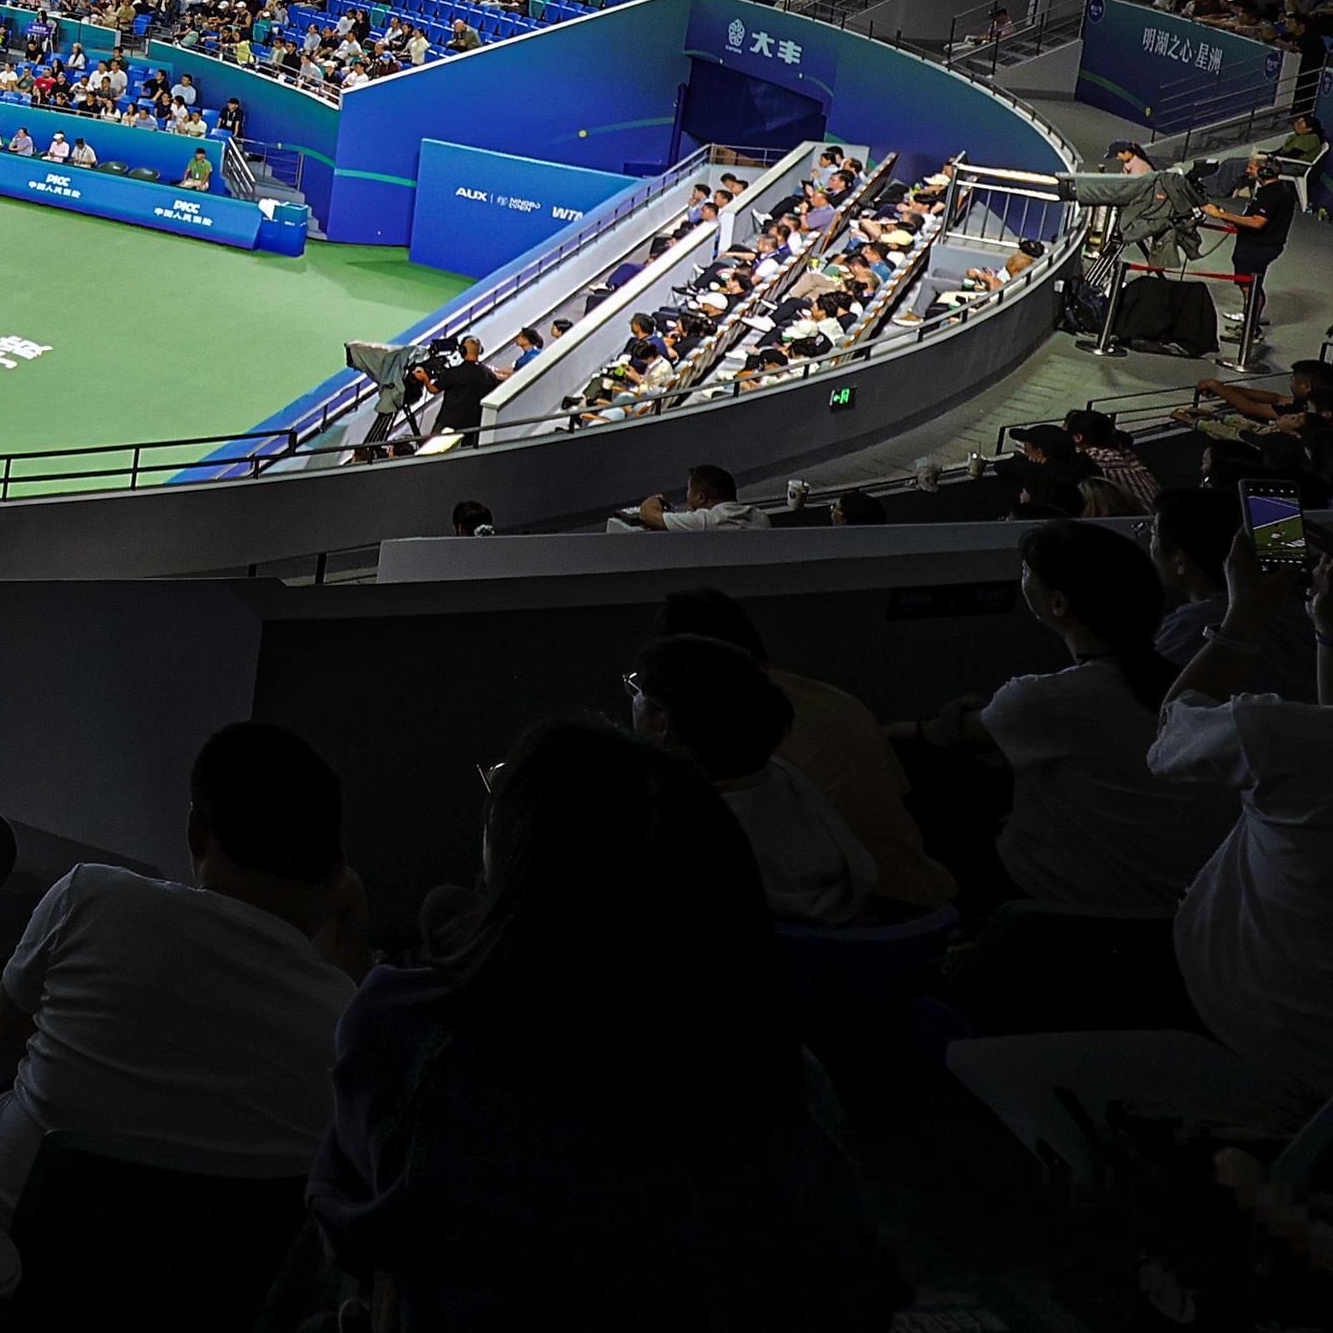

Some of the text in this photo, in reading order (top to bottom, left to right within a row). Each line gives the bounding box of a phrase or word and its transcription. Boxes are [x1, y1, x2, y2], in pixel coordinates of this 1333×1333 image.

[749, 31, 804, 65] 大丰
[1142, 26, 1224, 76] 明湖之心·星洲
[46, 173, 71, 187] PICC
[455, 187, 488, 202] AUX
[173, 199, 201, 215] PICC
